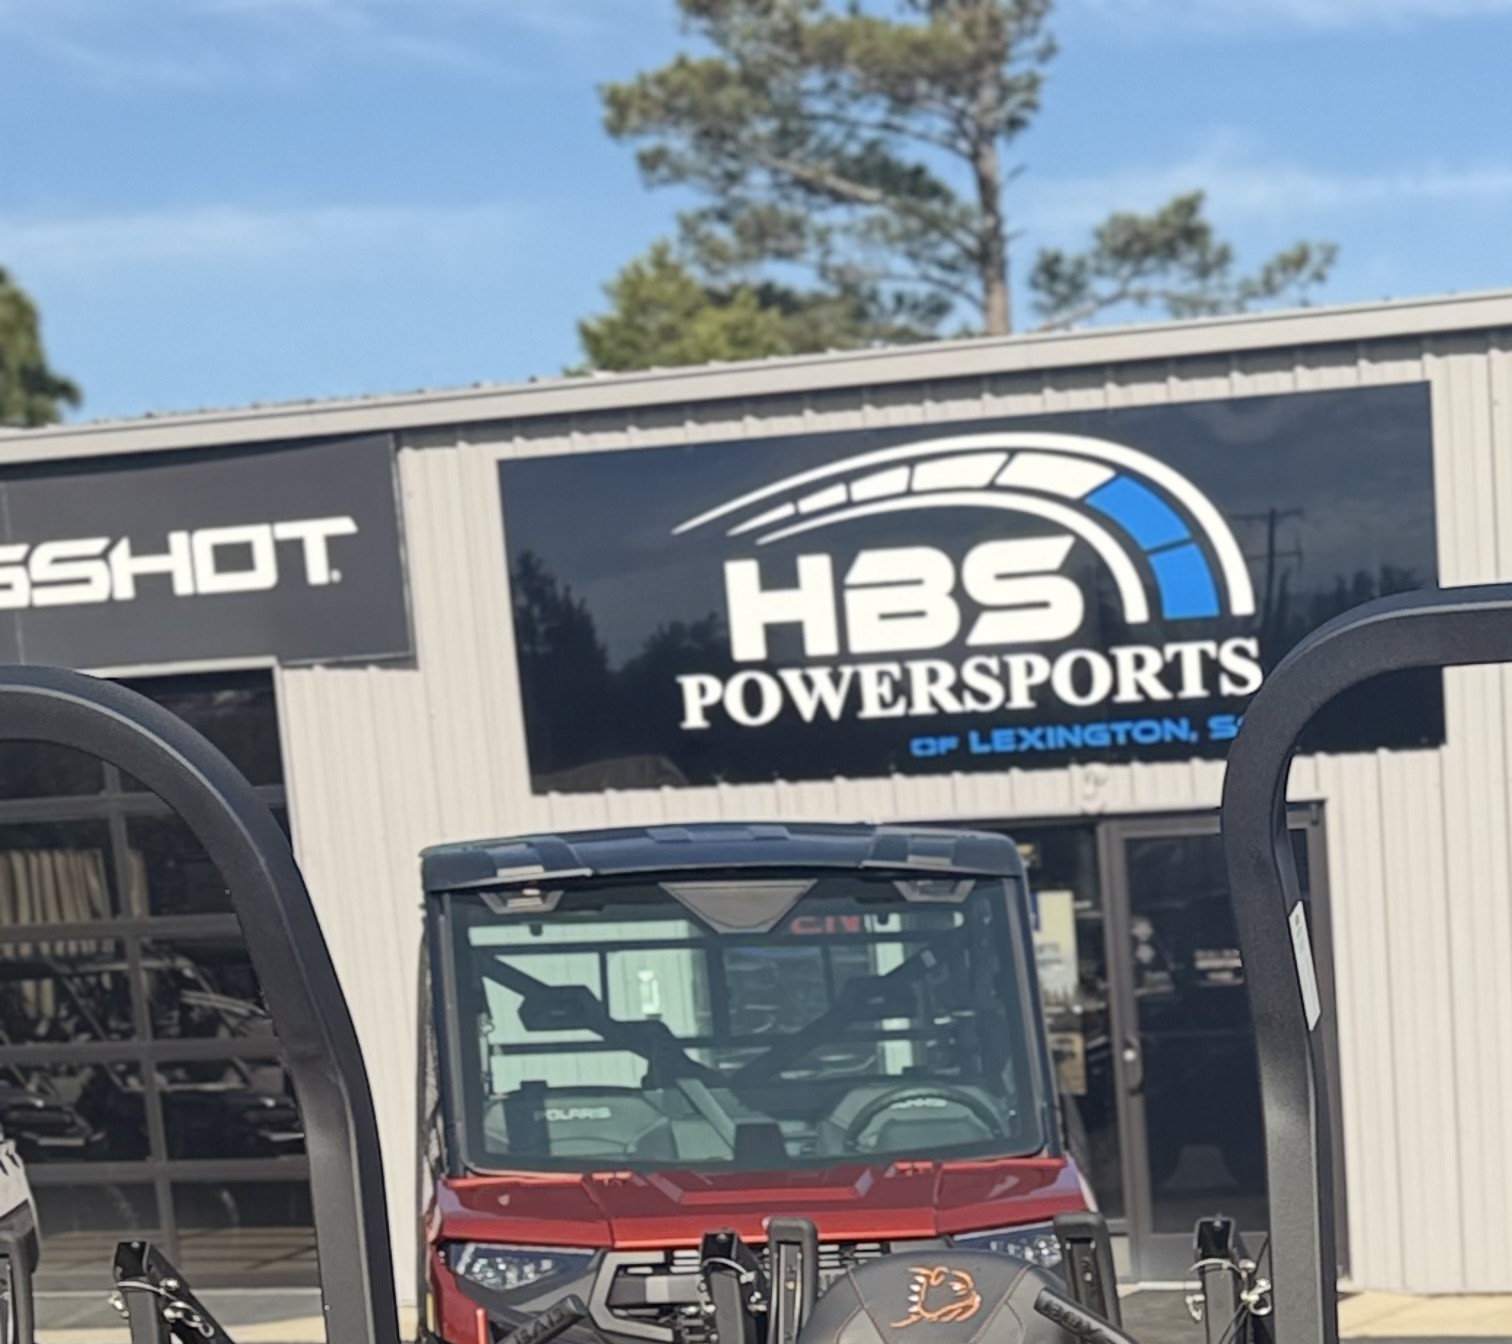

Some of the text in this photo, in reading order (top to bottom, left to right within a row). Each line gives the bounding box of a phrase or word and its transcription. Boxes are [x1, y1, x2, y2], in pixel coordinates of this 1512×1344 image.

[723, 535, 1085, 662] HBS
[675, 637, 1264, 730] POWERSPORTS
[909, 713, 1245, 758] OF LEXINGTON, S
